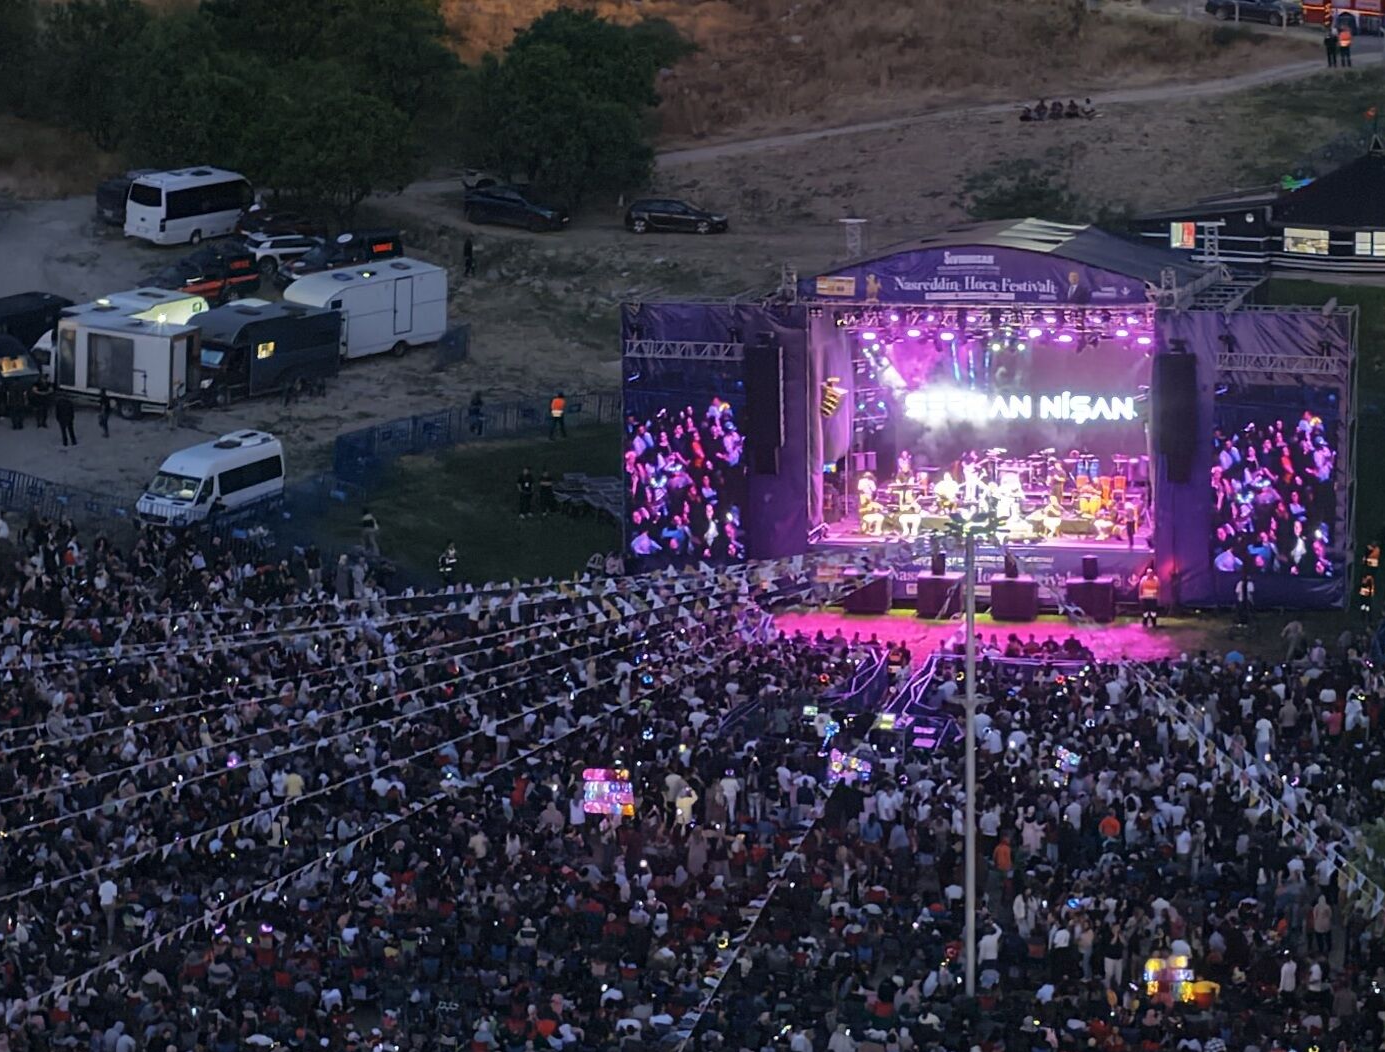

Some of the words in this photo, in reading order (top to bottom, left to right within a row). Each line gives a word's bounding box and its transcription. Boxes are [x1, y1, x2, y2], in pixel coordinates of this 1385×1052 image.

[894, 275, 961, 291] Nasreddin
[964, 275, 999, 291] Hoca
[1039, 391, 1134, 424] NİŞAN
